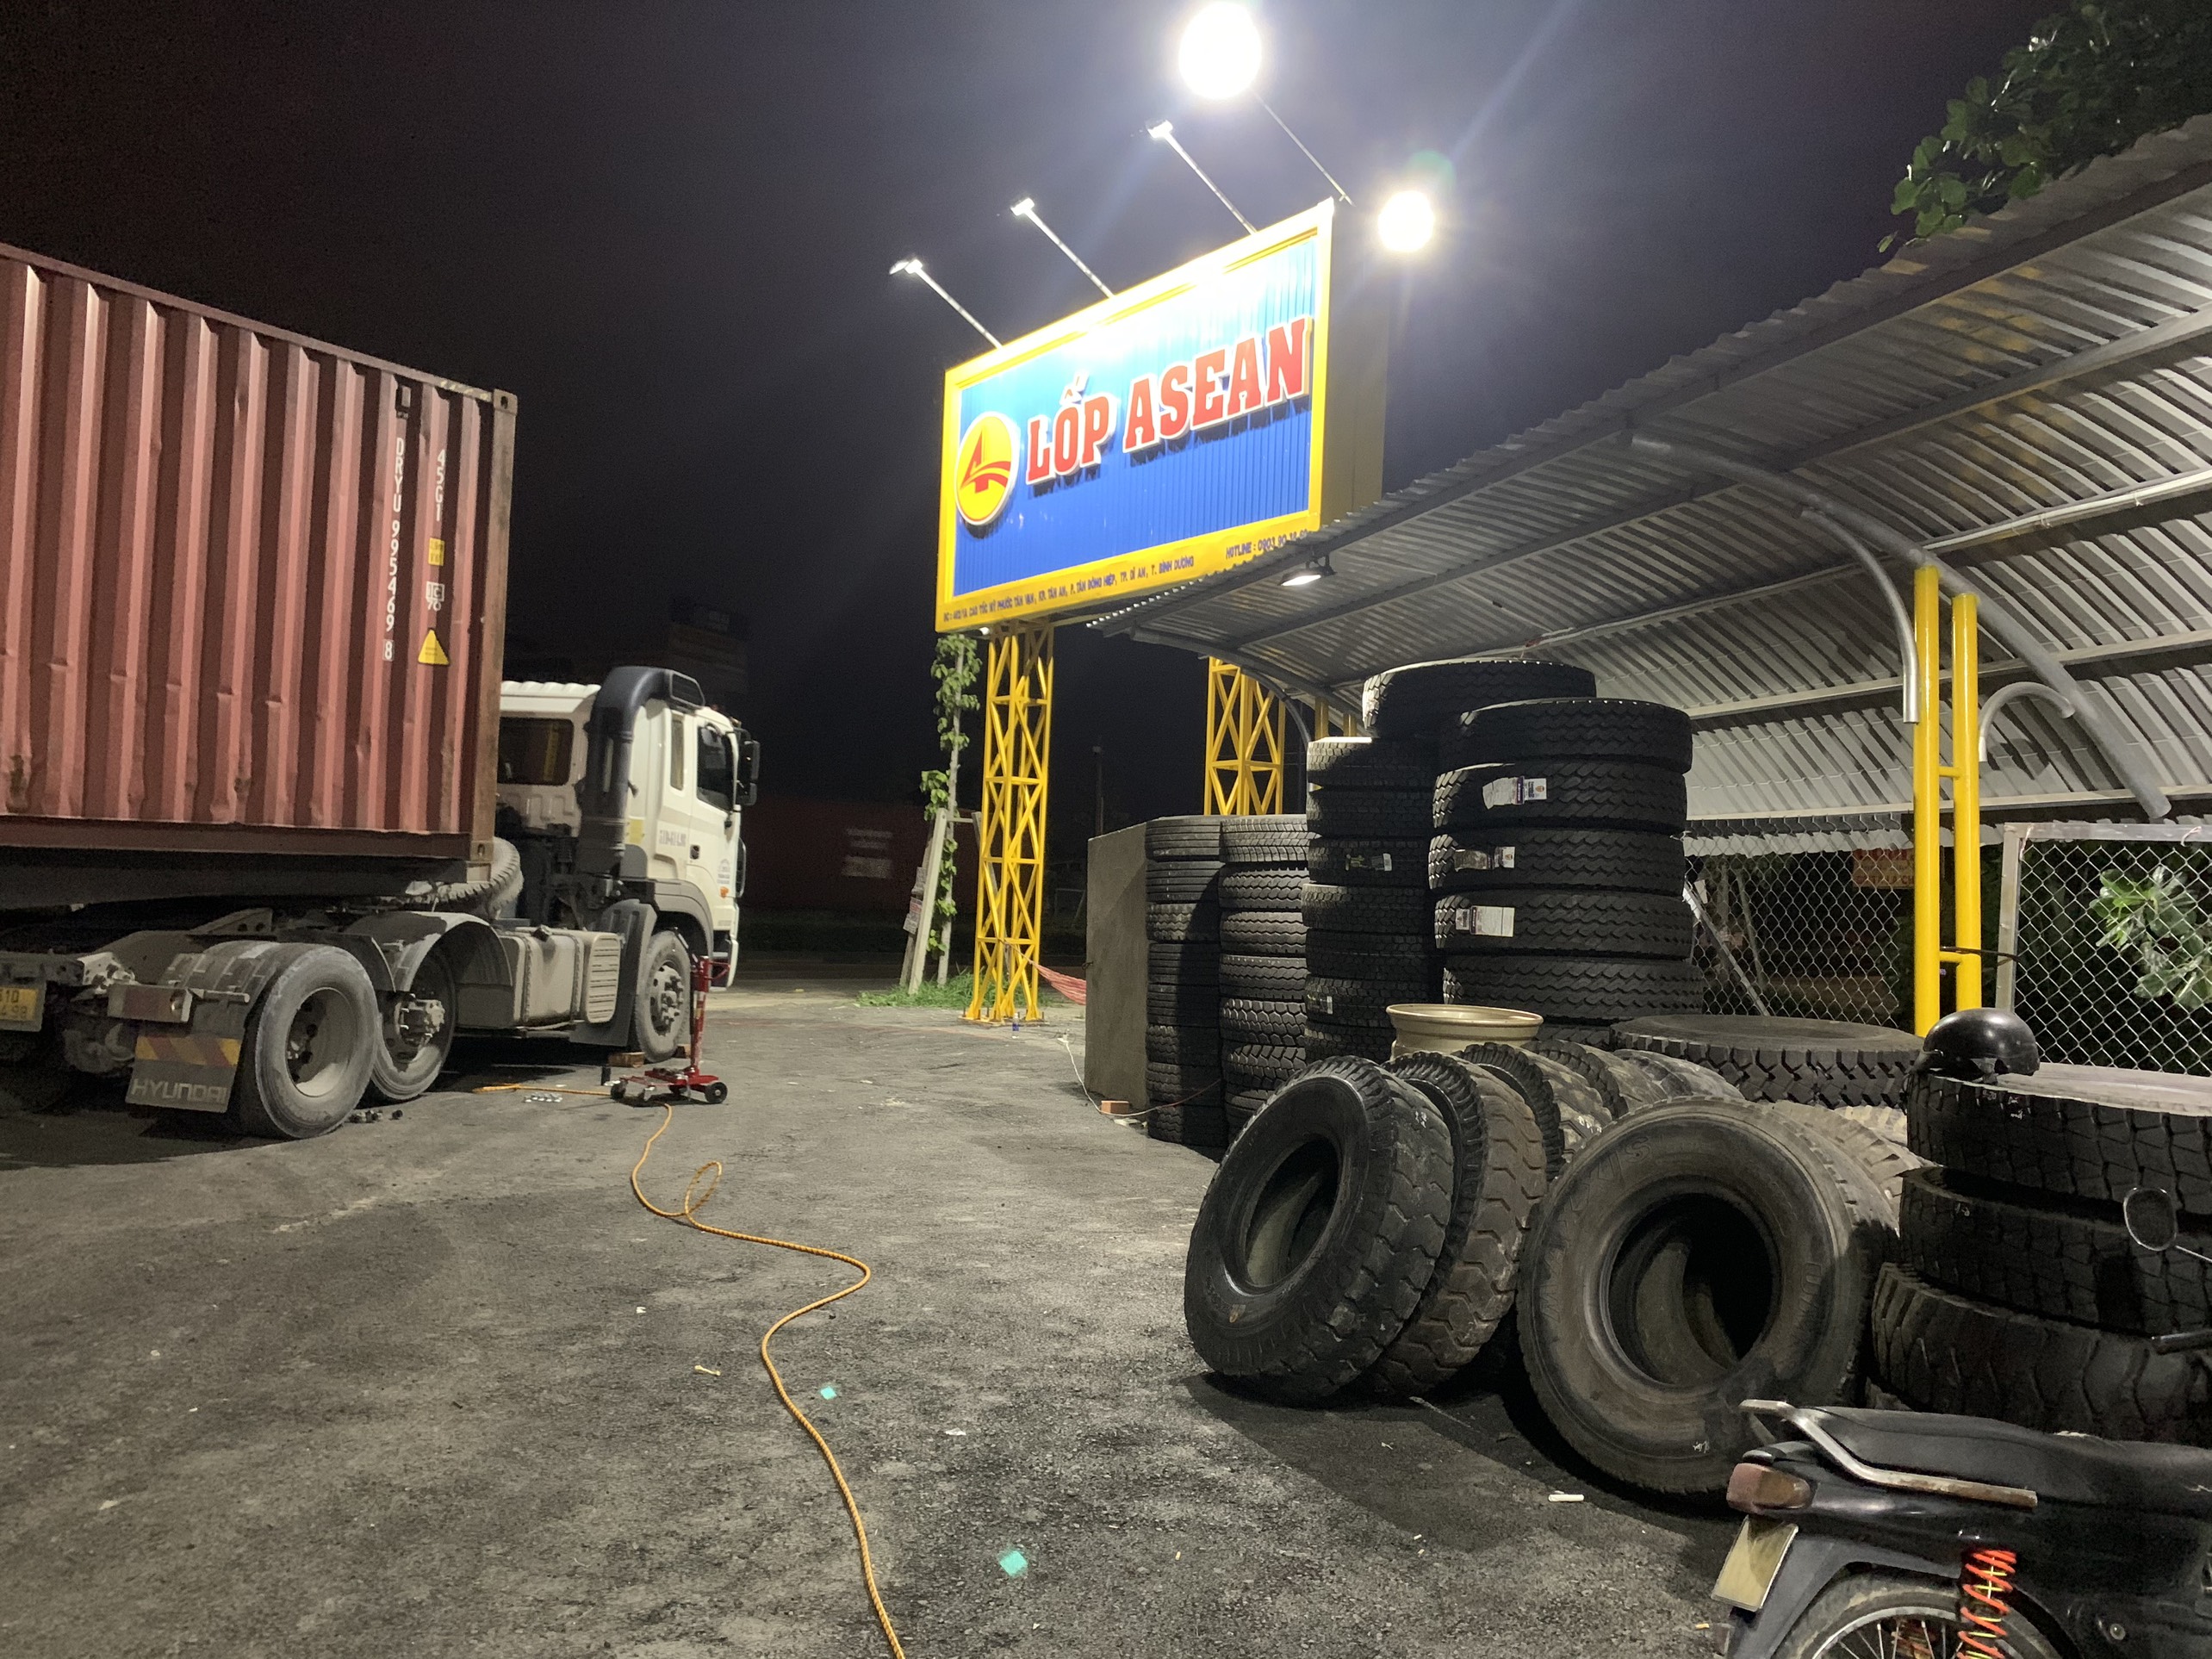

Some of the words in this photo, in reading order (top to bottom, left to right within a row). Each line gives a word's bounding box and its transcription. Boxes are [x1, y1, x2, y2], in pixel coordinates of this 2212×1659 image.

[1026, 370, 1118, 486] LỐP
[1122, 314, 1314, 453] ASEAN
[393, 438, 405, 513] DRYU
[434, 449, 446, 522] 45G1
[385, 519, 401, 632] 995469
[384, 640, 393, 661] 8
[130, 1078, 227, 1104] HYUNDAI
